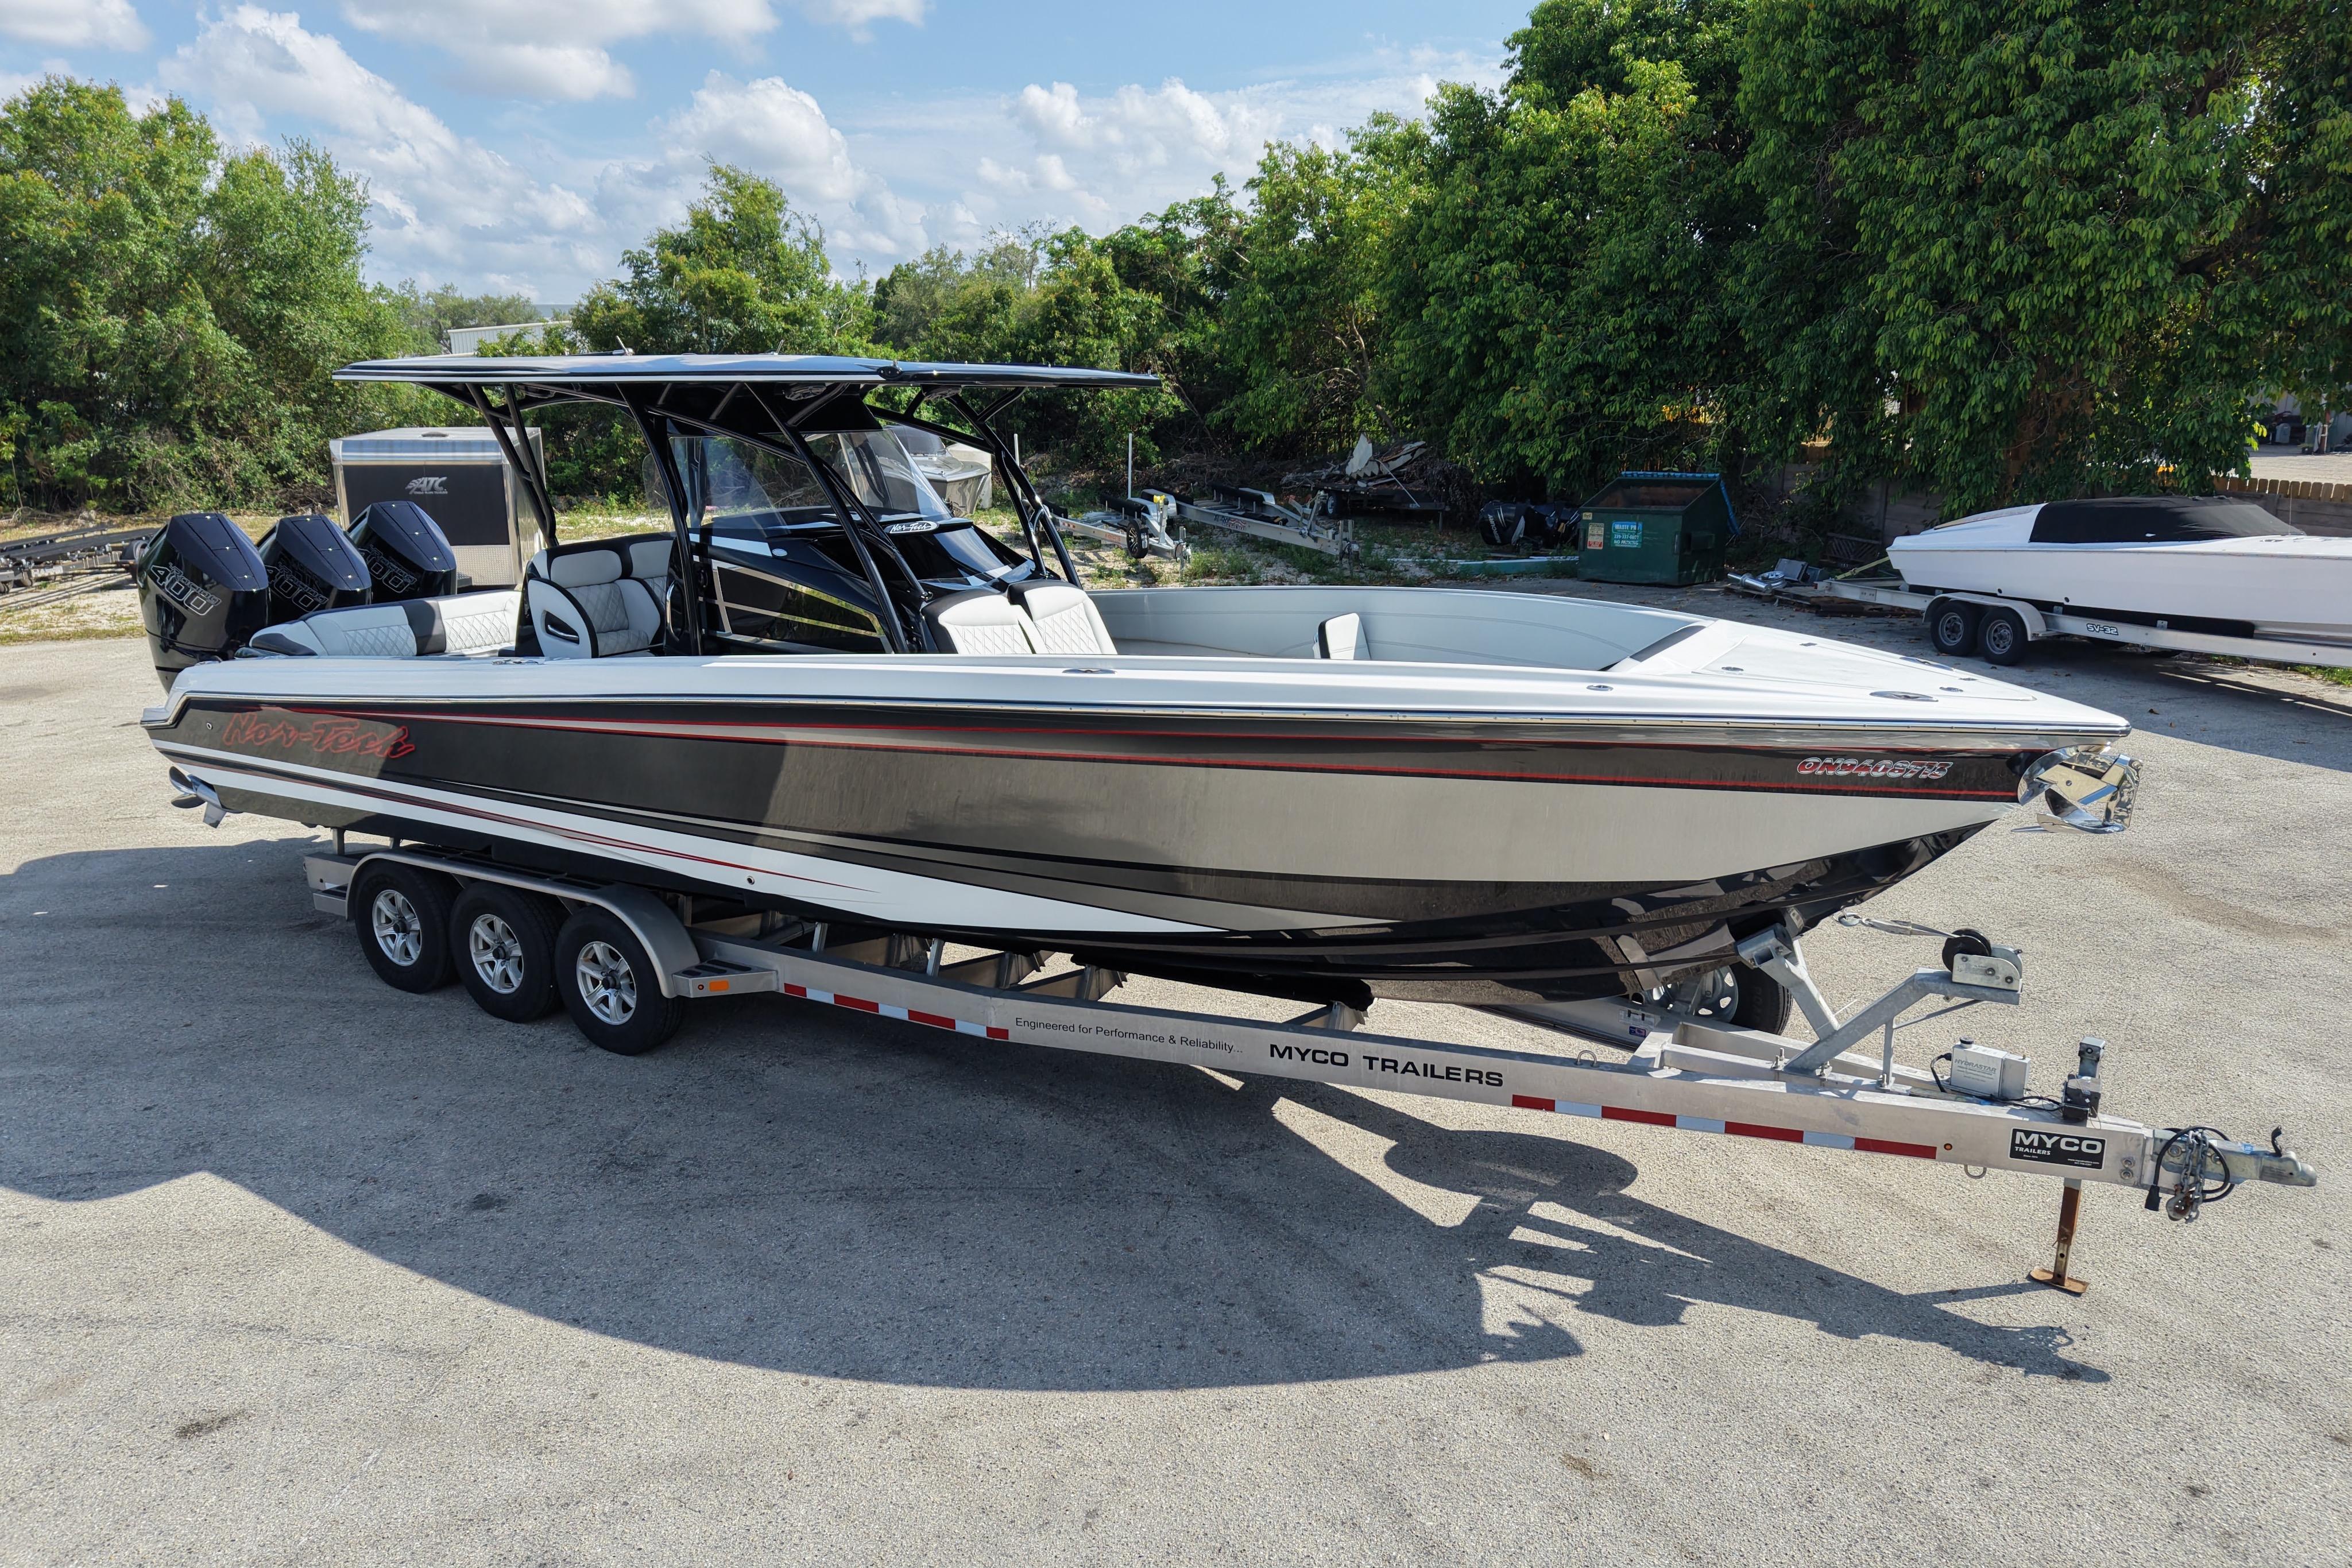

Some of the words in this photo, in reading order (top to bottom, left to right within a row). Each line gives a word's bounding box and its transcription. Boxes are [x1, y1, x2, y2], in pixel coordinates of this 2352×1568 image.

[409, 477, 447, 493] ATC
[892, 522, 931, 532] Nor-Tech
[150, 565, 215, 615] 400
[2086, 623, 2119, 636] SV-32
[222, 712, 415, 758] Nor-Tech
[1015, 1017, 1075, 1032] Engineered
[1079, 1024, 1093, 1034] for
[1096, 1026, 1165, 1043] Performance
[1169, 1035, 1177, 1044] &
[1270, 1044, 1349, 1067] MYCO
[1363, 1055, 1503, 1087] TRAILERS
[1955, 1058, 1997, 1073] HYDRASTAR
[2014, 1146, 2051, 1156] TRAILERS
[2015, 1131, 2102, 1154] MYCO
